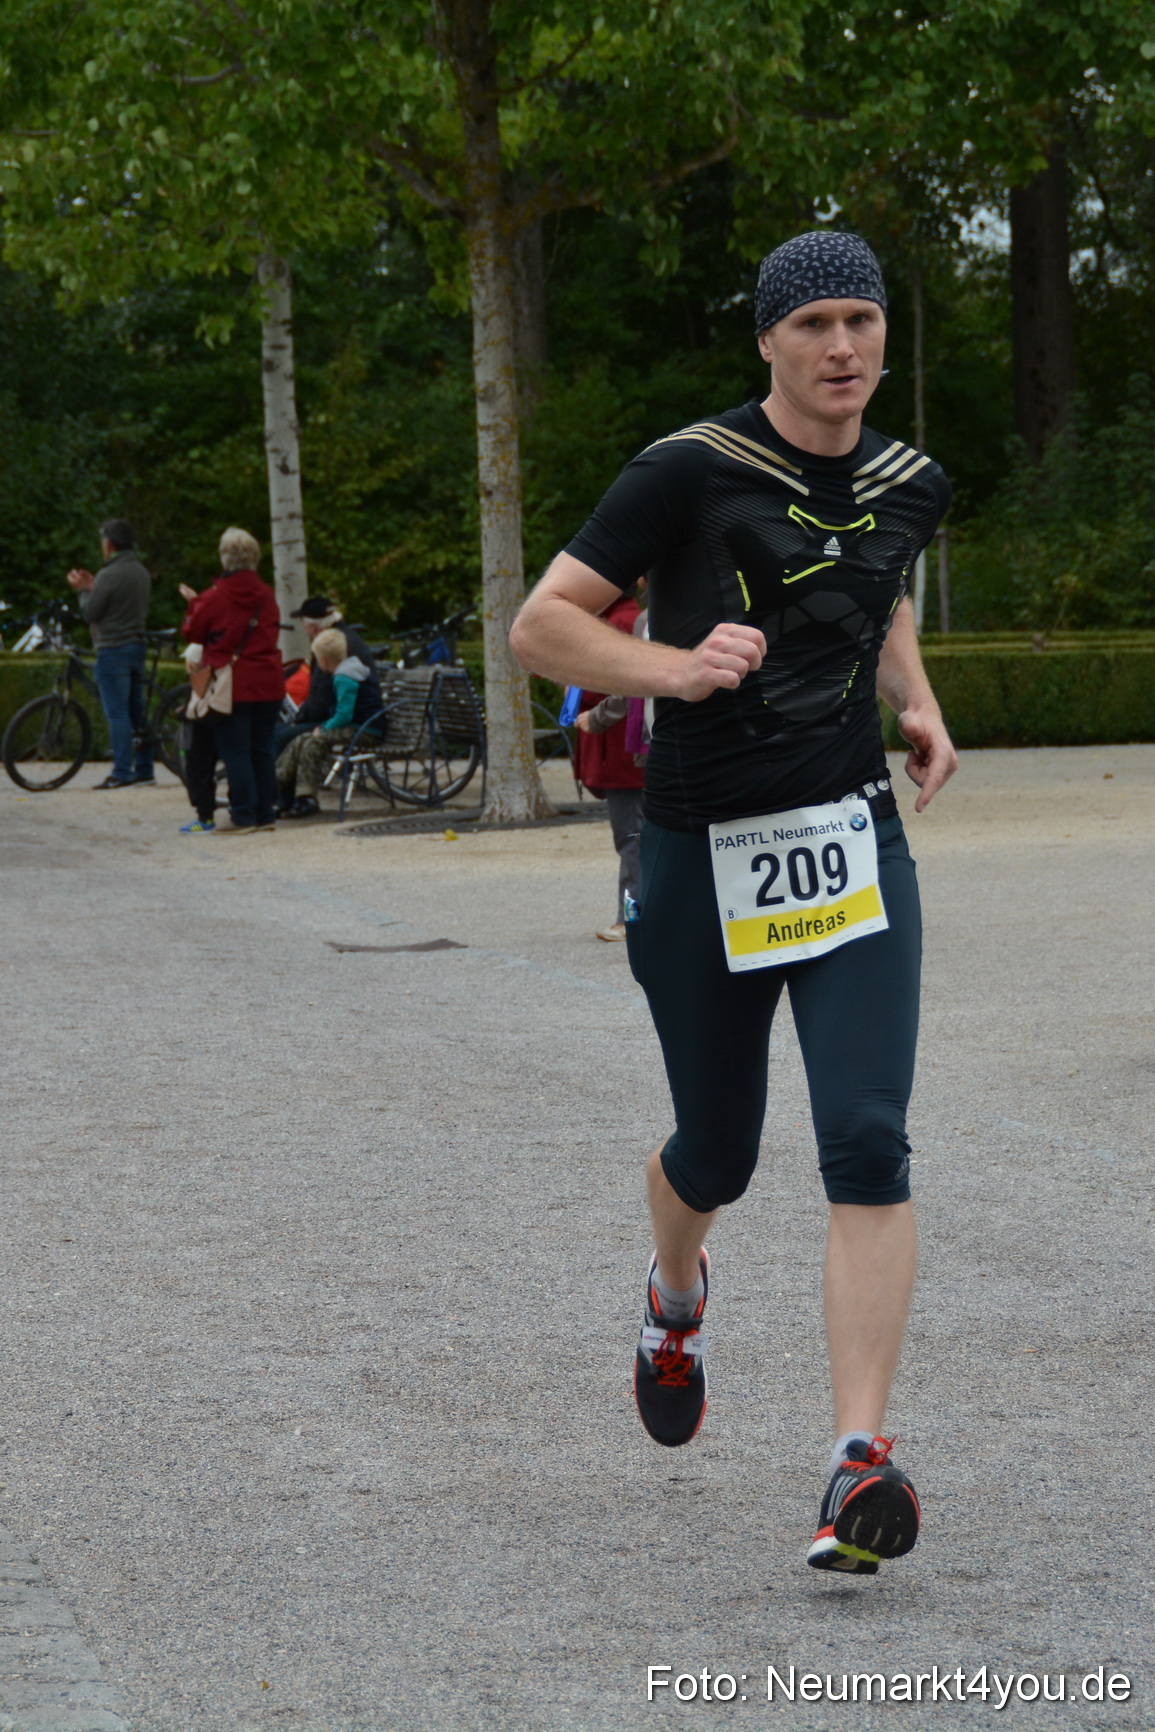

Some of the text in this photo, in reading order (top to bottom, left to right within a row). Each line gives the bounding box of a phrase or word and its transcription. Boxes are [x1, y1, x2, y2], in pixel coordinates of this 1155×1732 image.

[715, 820, 845, 851] PARTL Neumarkt
[751, 842, 848, 908] 209
[728, 909, 734, 919] B
[766, 910, 846, 944] Andreas
